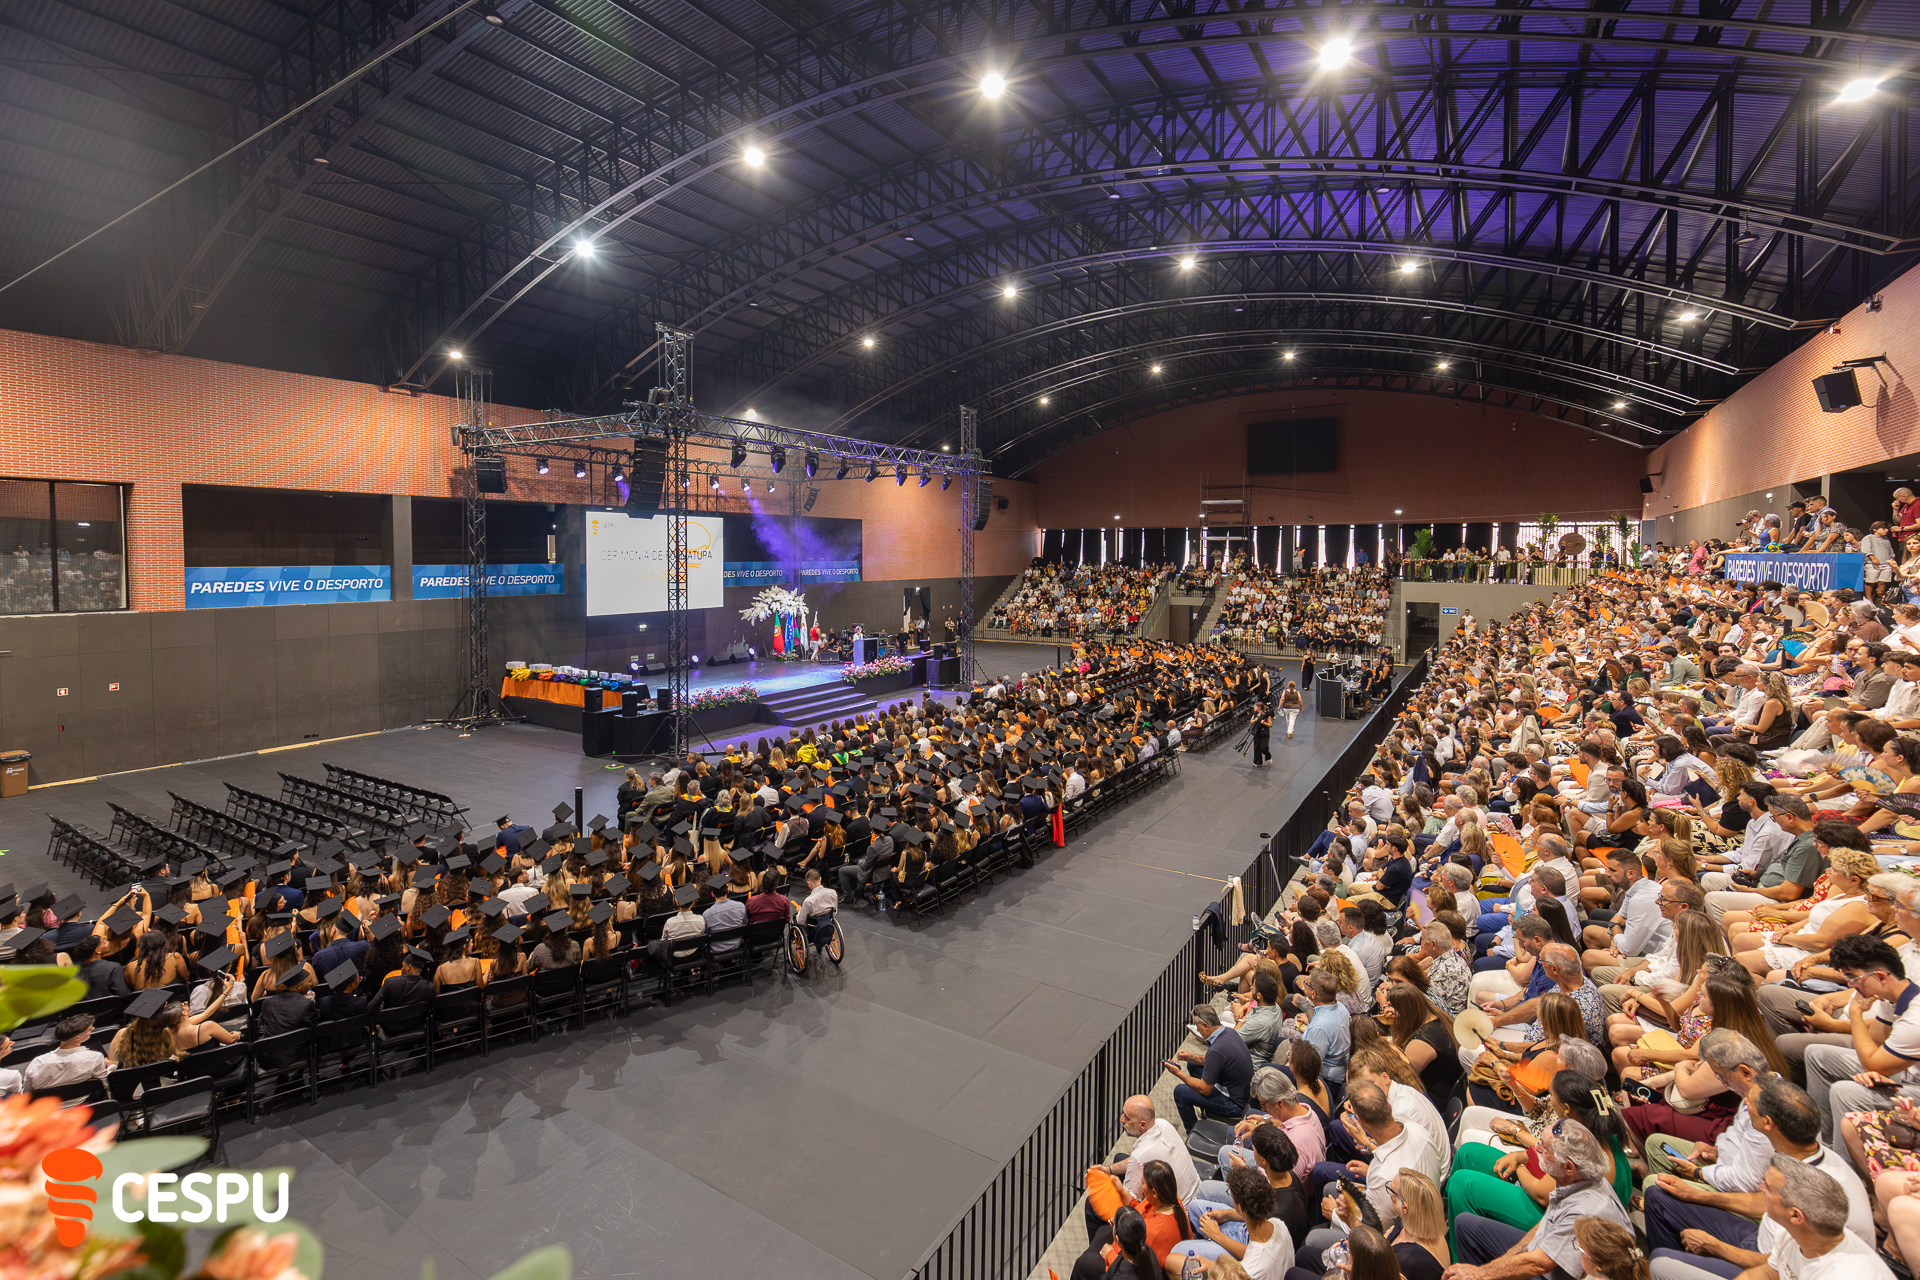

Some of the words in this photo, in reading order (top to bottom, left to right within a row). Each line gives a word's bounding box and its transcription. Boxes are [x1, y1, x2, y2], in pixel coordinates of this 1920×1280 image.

[652, 550, 663, 560] DE
[736, 570, 750, 578] VIVE
[750, 570, 755, 578] O
[755, 569, 783, 577] DESPORTO
[1727, 560, 1756, 582] PAREDES
[1773, 561, 1780, 582] O
[1780, 561, 1830, 591] DESPORTO
[190, 580, 265, 594] PAREDES
[269, 580, 301, 592] VIVE
[303, 579, 314, 591] O
[316, 578, 384, 591] DESPORTO
[420, 576, 470, 587] PAREDES
[498, 575, 506, 585] O
[507, 574, 555, 585] DESPORTO
